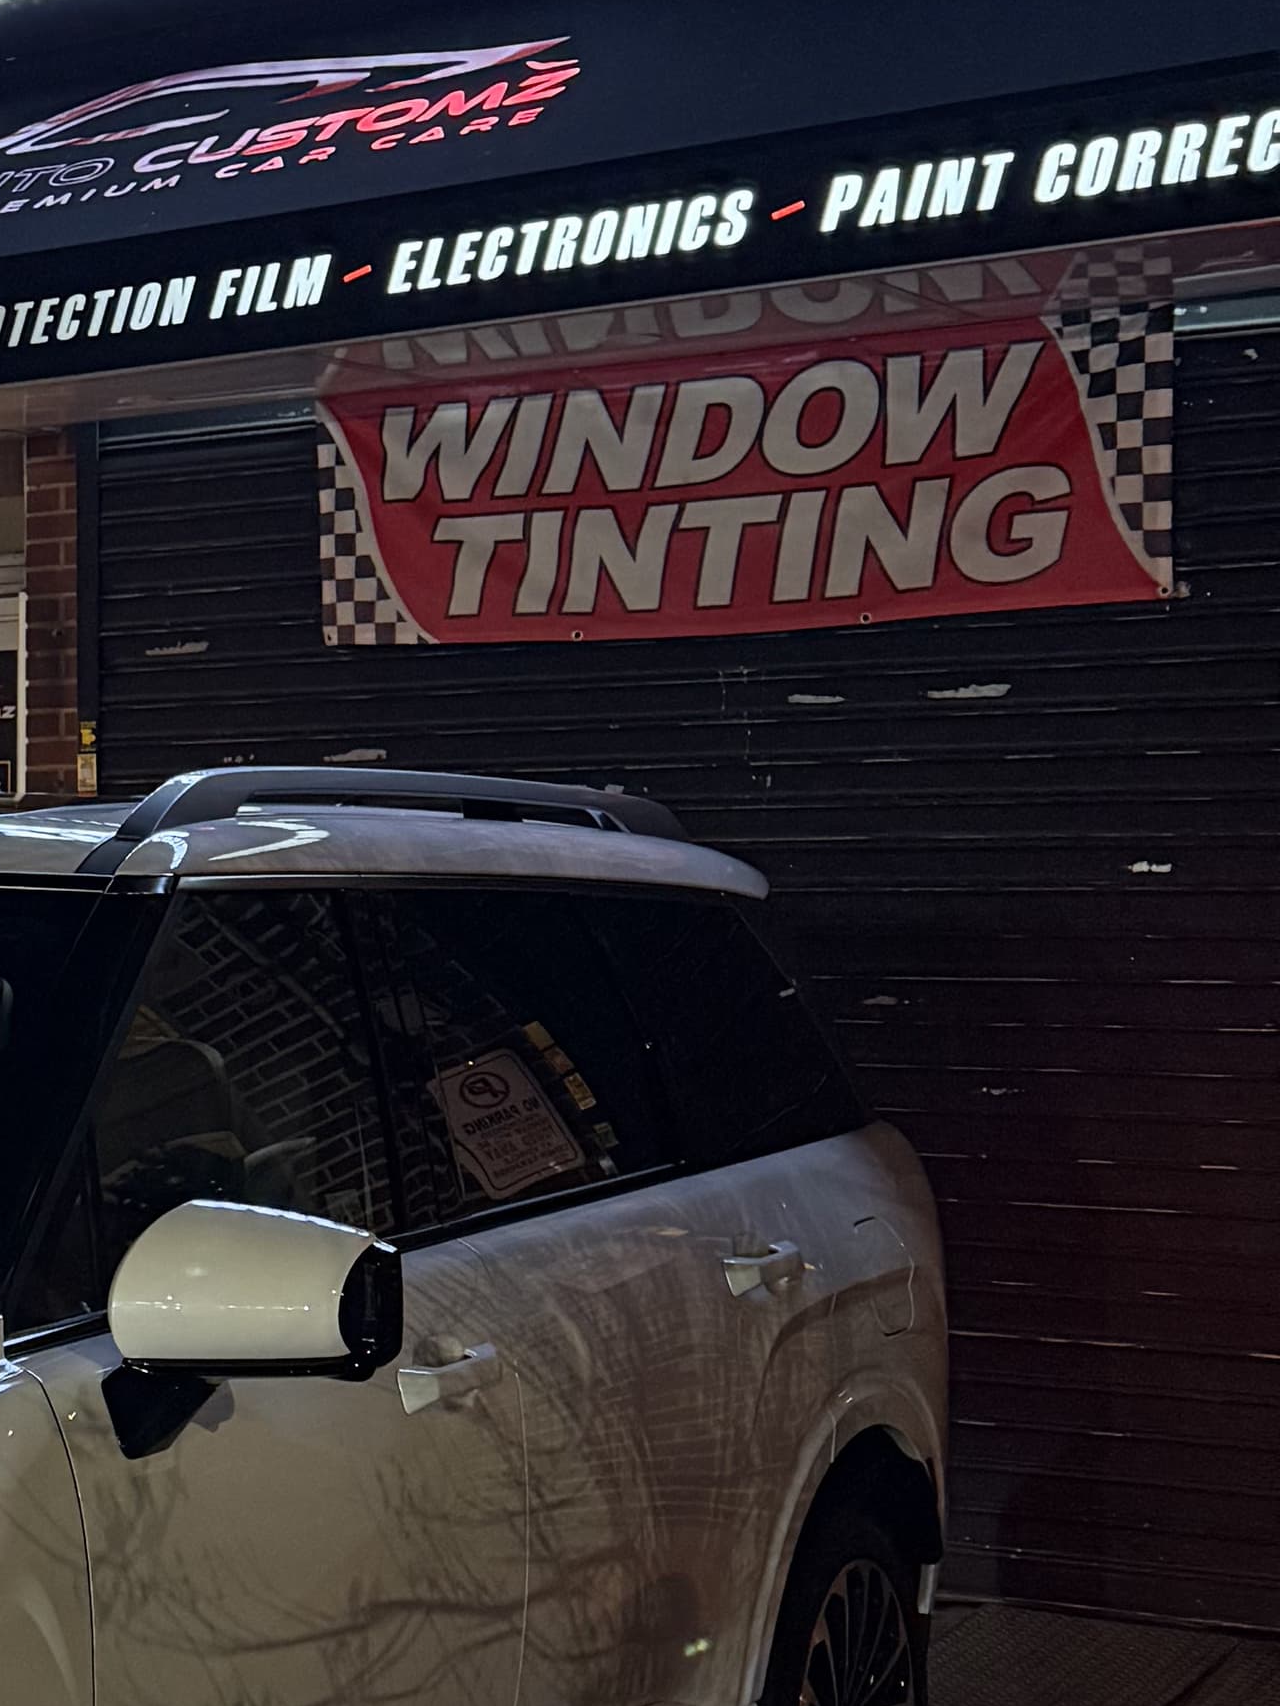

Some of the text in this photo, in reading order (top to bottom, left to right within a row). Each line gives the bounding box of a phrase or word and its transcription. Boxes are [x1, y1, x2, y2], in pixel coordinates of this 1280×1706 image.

[209, 253, 332, 320] FILM
[387, 189, 754, 294] ELECTRONICS
[819, 151, 1014, 233] PAINT
[1034, 108, 1280, 203] CORREC
[216, 146, 337, 179] CAR
[370, 107, 544, 150] CARE
[381, 340, 1047, 502] WINDOW
[432, 464, 1072, 617] TINTING
